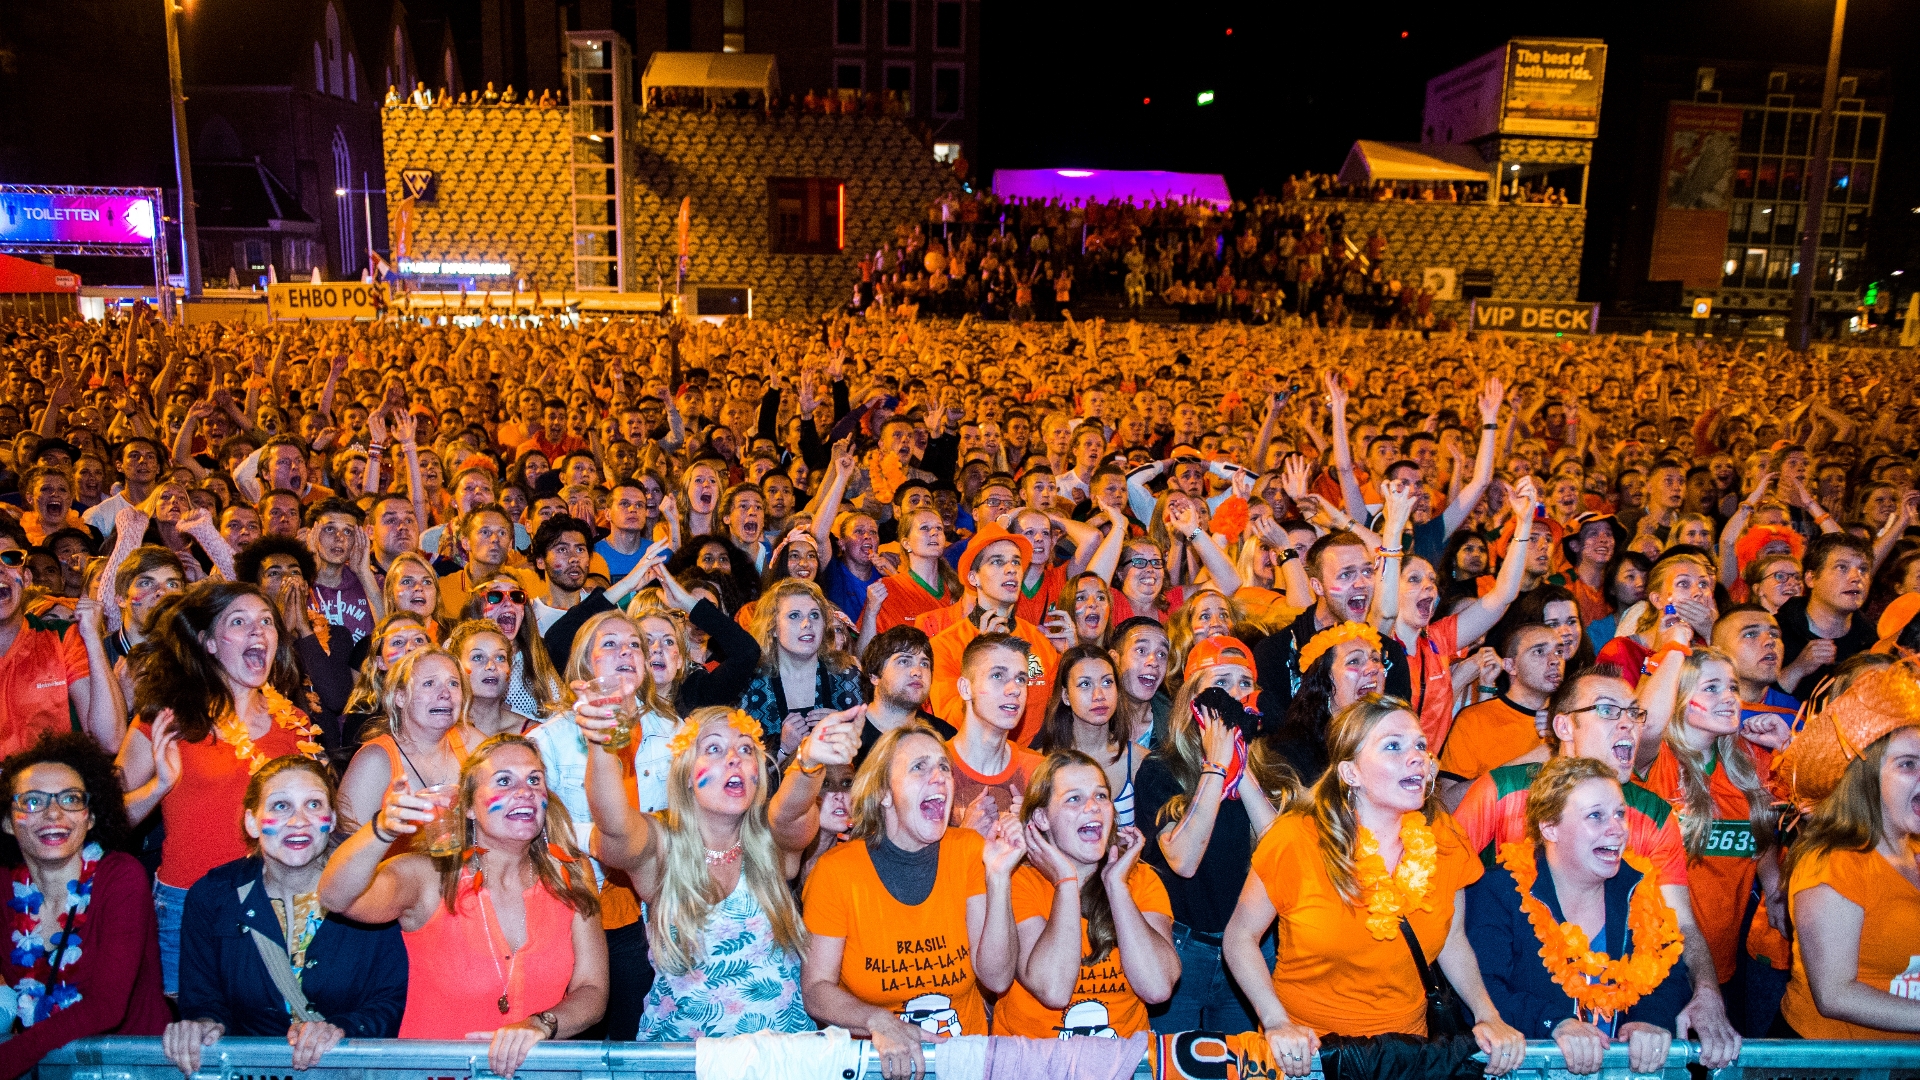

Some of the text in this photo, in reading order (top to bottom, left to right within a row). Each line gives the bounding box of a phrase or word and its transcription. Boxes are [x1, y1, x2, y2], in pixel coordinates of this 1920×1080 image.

[1517, 48, 1586, 66] The best of
[1514, 64, 1593, 80] both worlds.
[23, 207, 100, 222] TOILETTEN
[288, 288, 338, 308] EHBO
[1477, 305, 1590, 330] VIP DECK
[896, 935, 947, 954] BRASIL!
[881, 968, 967, 992] LA-LA-LAAA
